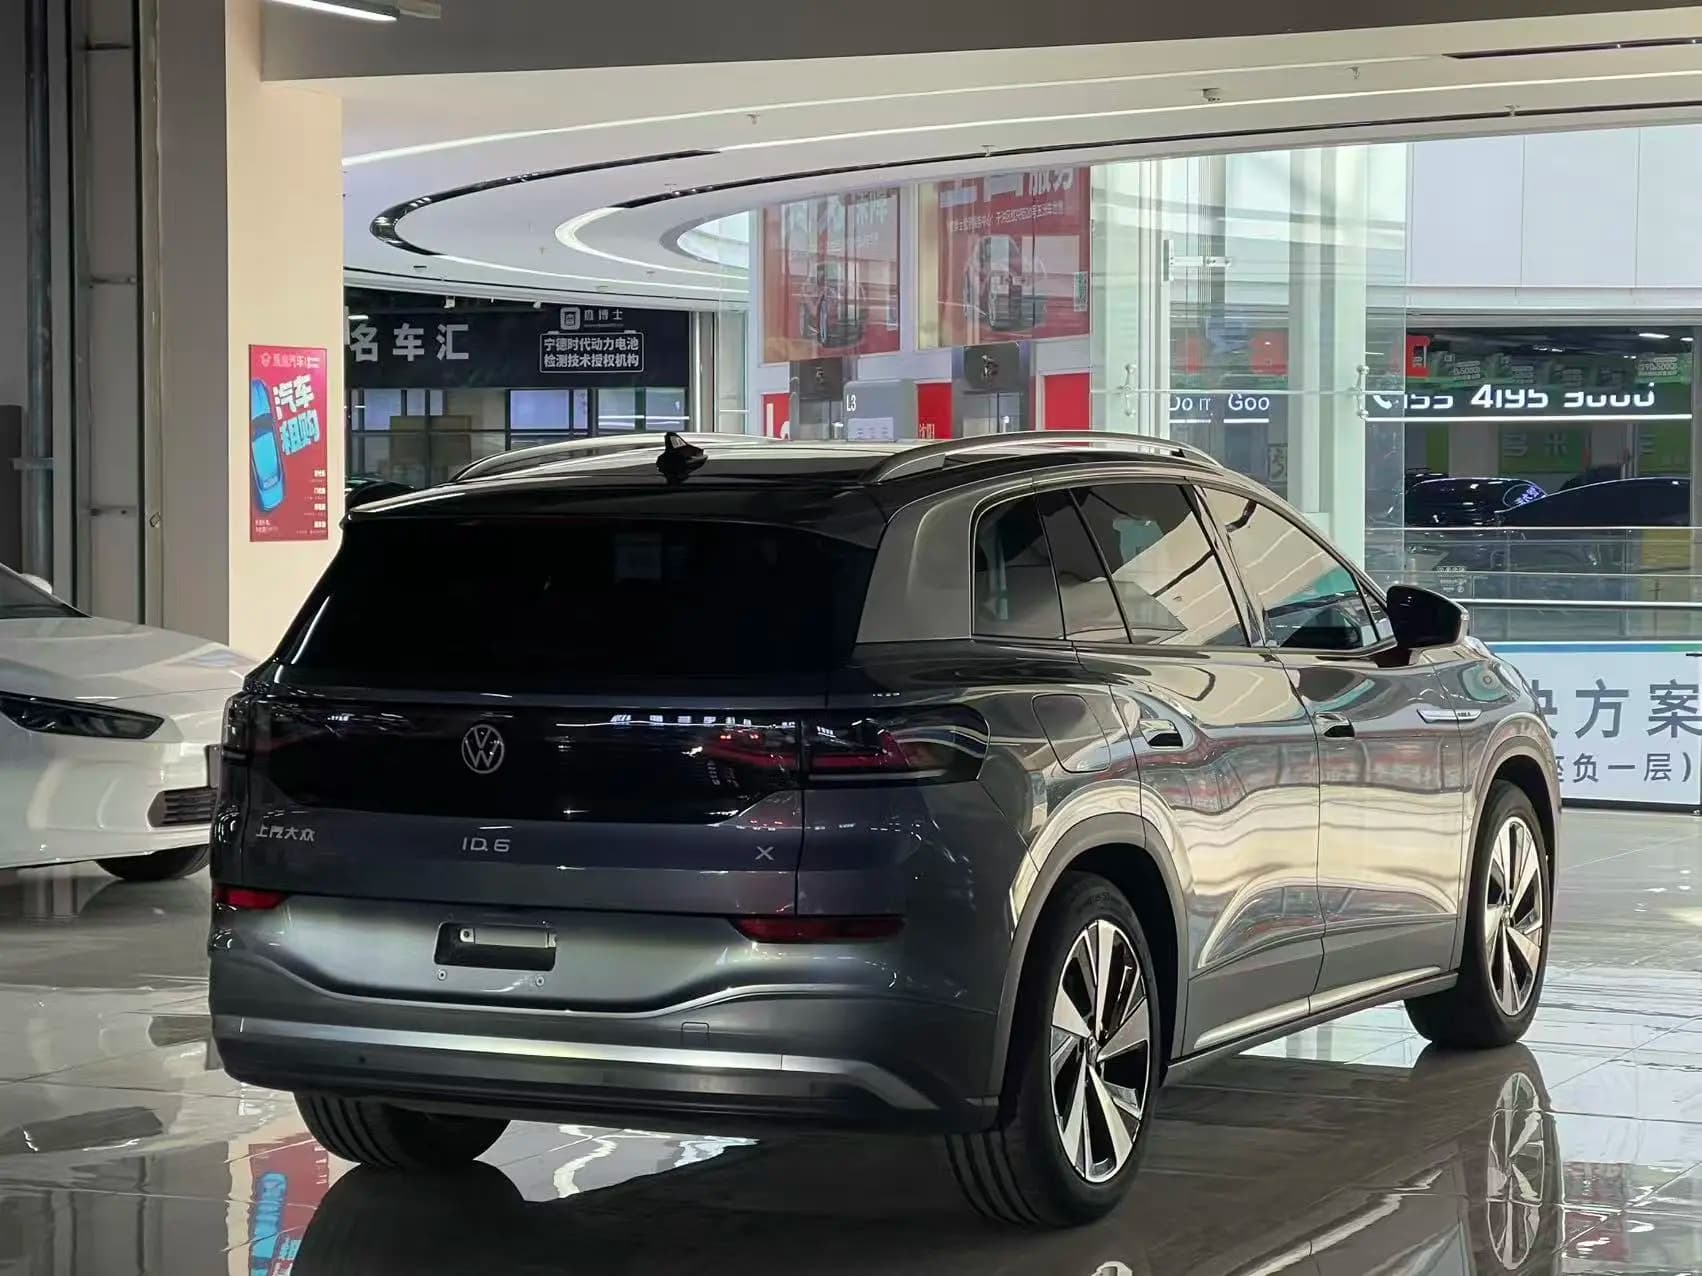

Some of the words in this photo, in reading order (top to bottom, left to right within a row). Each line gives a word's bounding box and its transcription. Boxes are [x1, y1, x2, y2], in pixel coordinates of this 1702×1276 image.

[350, 323, 469, 362] 名车汇
[544, 337, 639, 351] 宁德时代动力电池
[544, 353, 639, 367] 检测技术授权机构
[273, 374, 314, 420] 汽车
[846, 394, 857, 411] L3
[256, 825, 315, 842] 上汽大众
[755, 846, 775, 861] X
